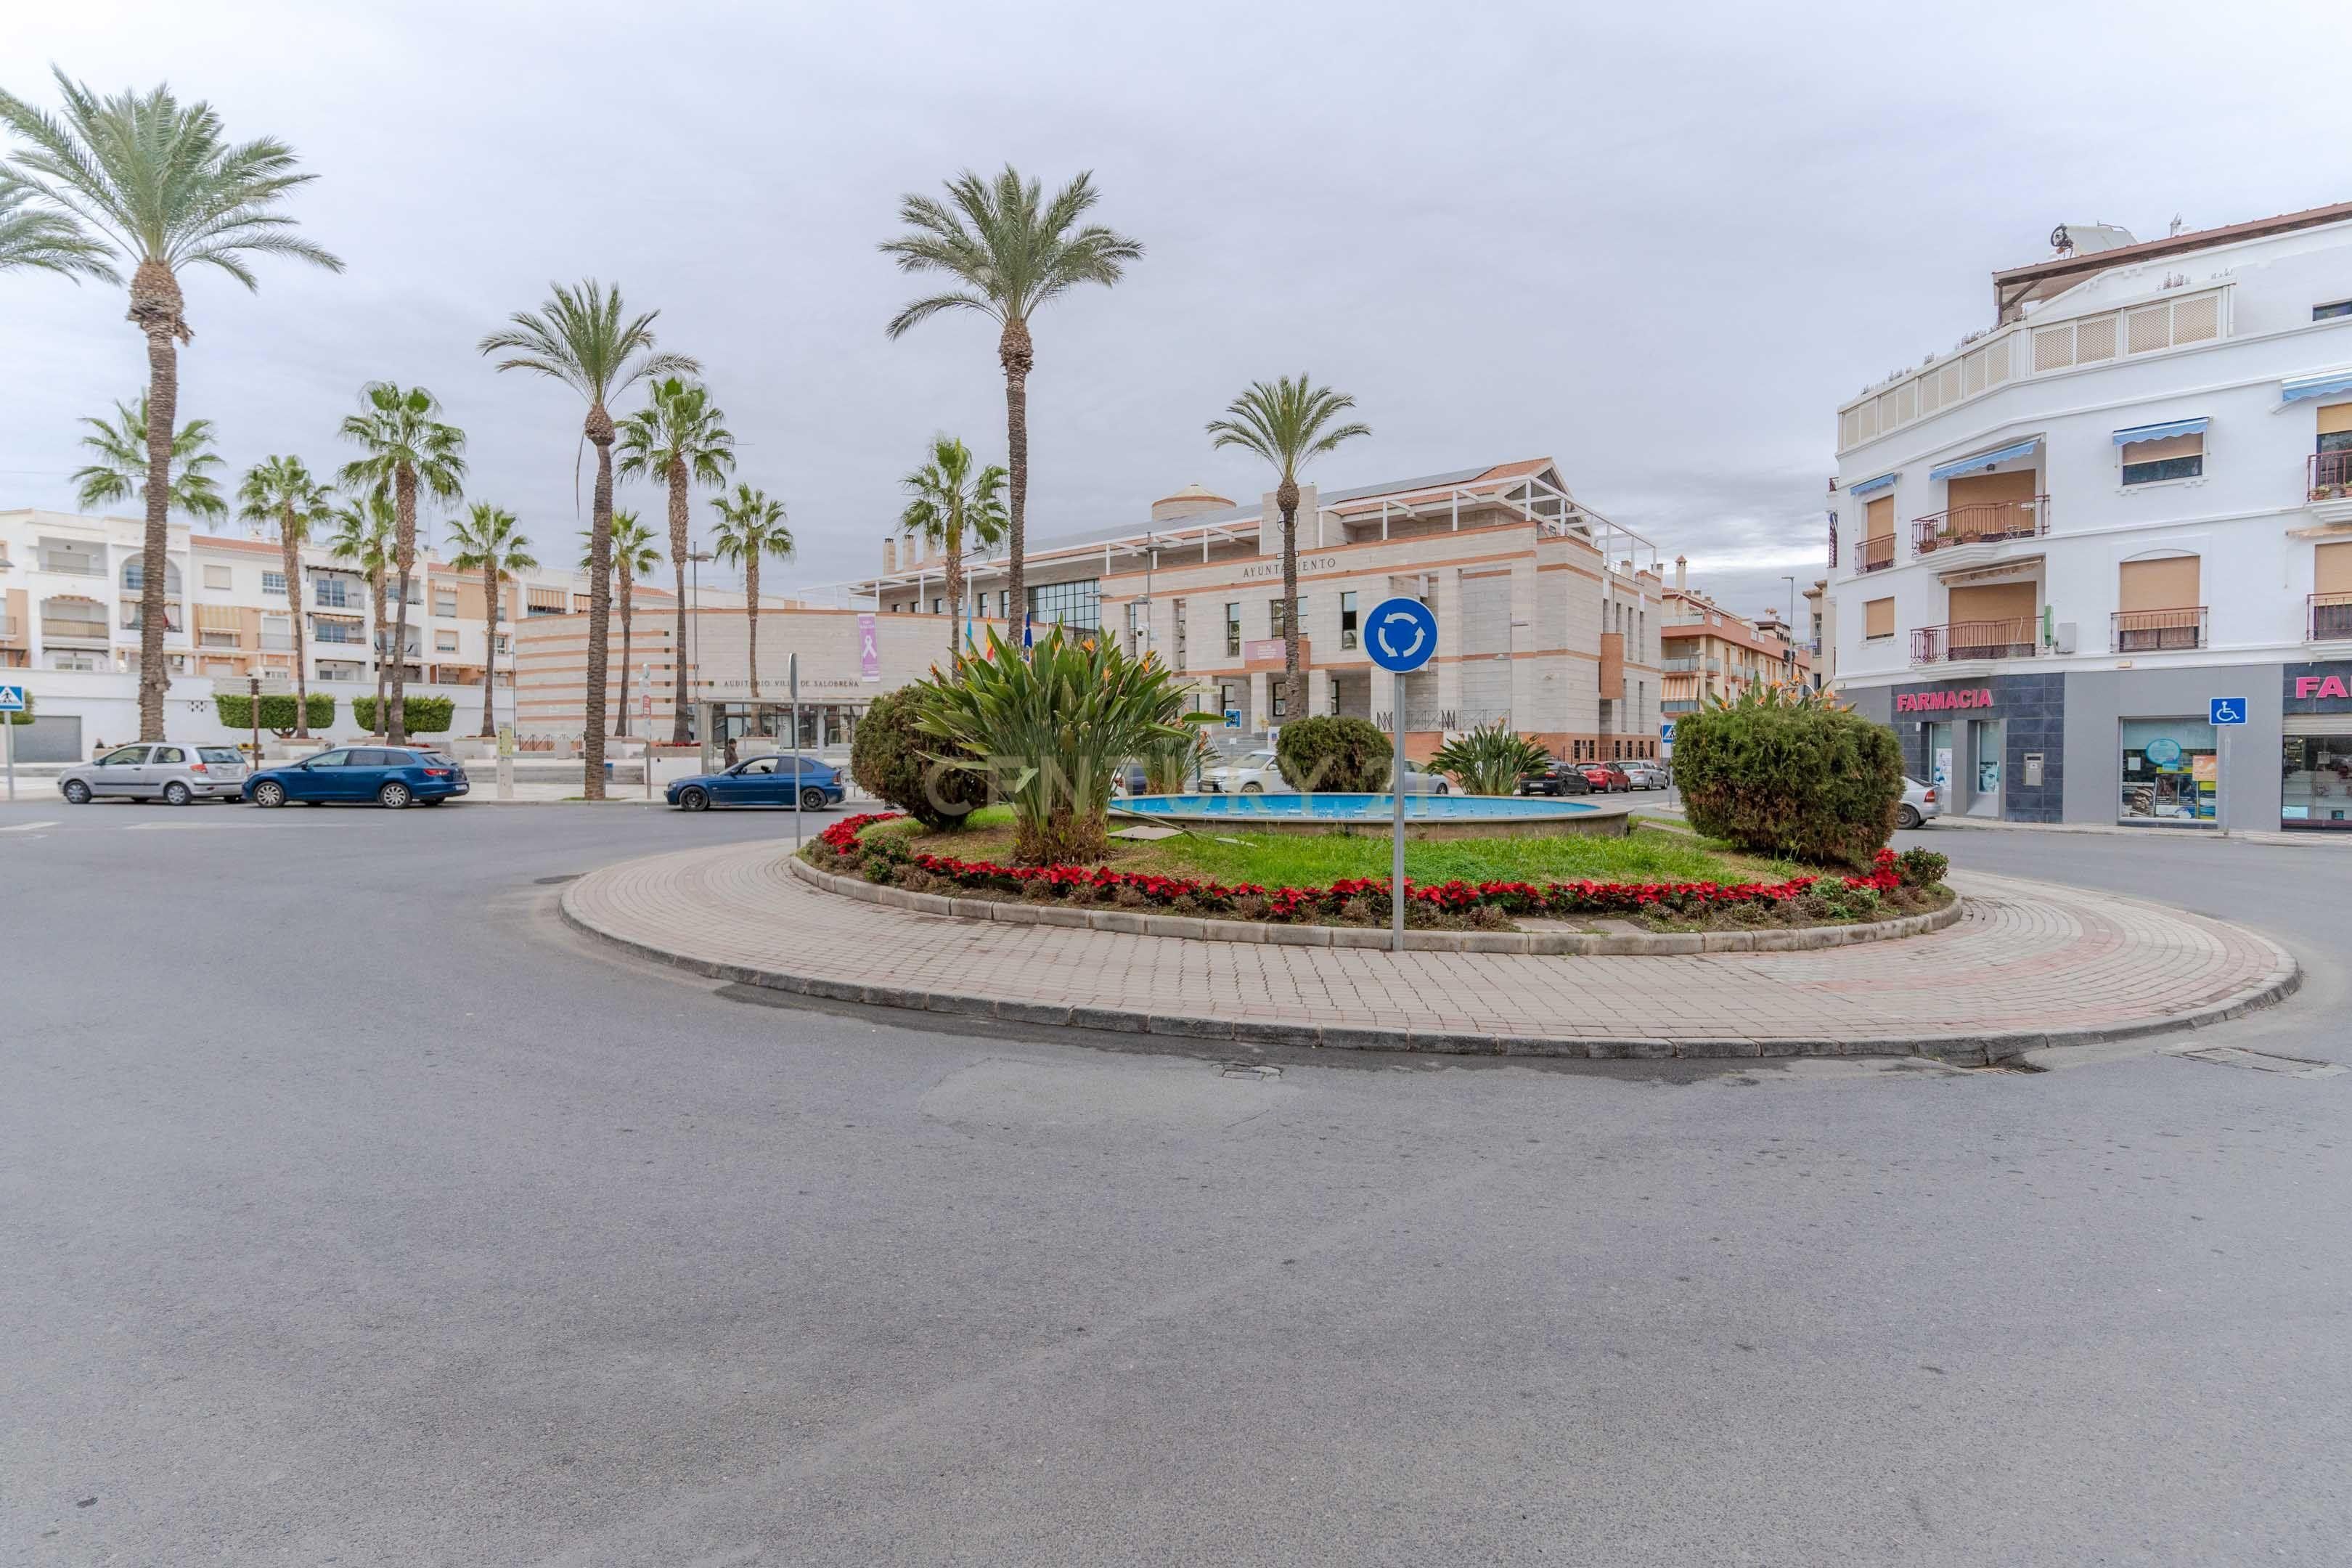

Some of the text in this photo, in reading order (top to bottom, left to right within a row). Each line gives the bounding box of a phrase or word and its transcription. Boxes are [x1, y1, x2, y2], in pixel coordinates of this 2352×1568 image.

[1244, 558, 1336, 578] AYUNTAIENTO
[814, 678, 859, 687] SALOBREÑA
[2296, 675, 2352, 698] FA
[1897, 688, 1994, 711] FARMACIA
